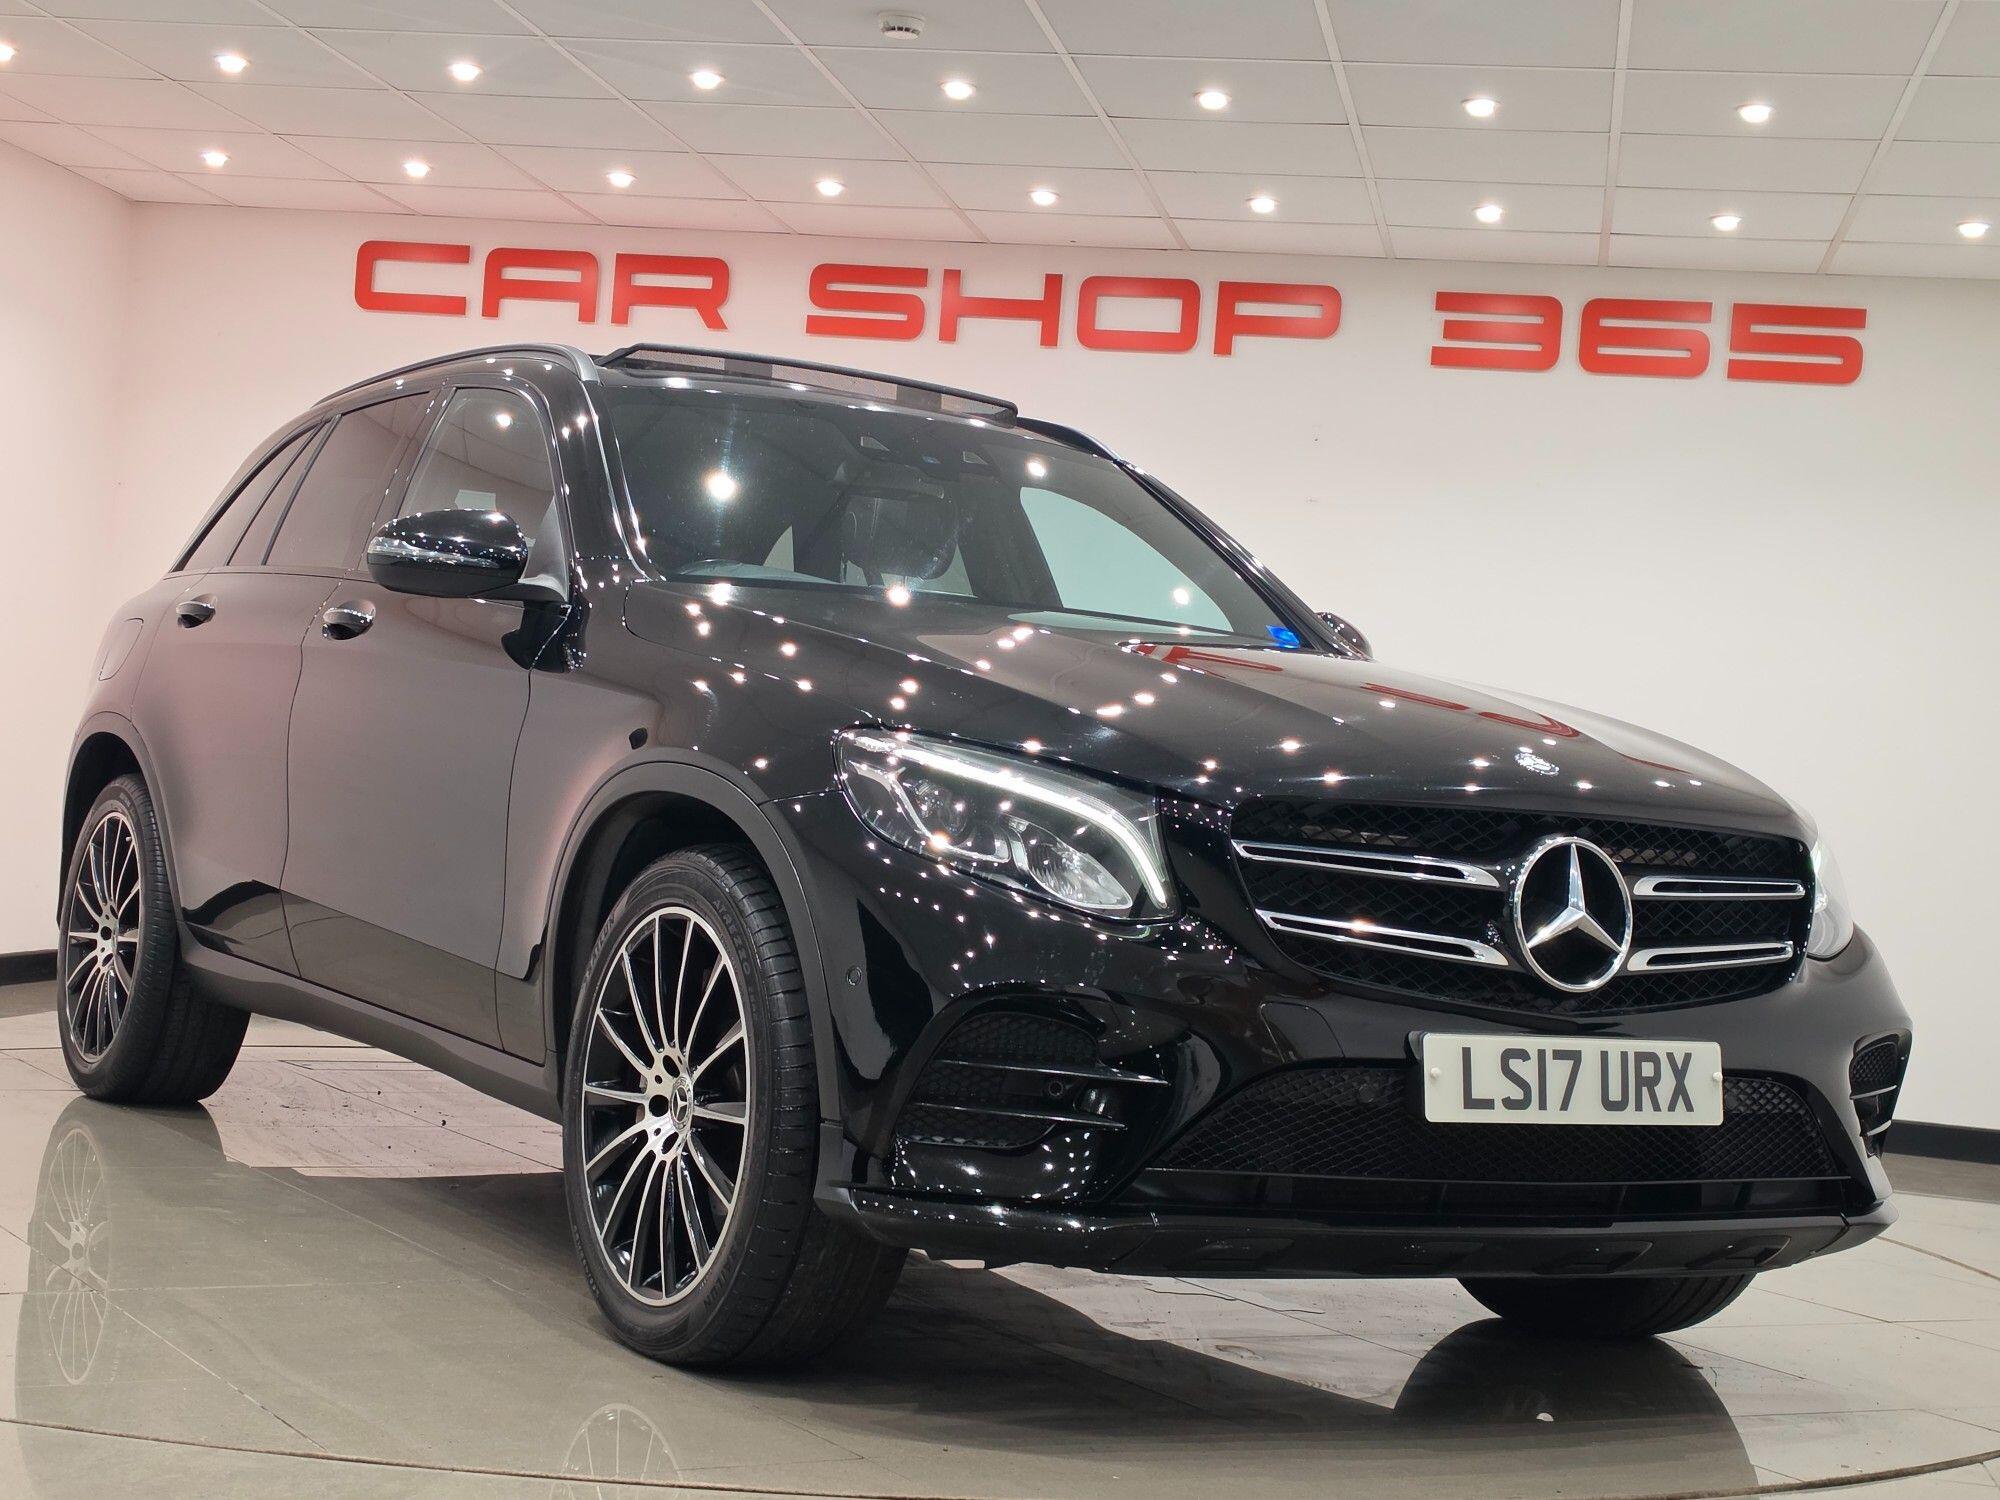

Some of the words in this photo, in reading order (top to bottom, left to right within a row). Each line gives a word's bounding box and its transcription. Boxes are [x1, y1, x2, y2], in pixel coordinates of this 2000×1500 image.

[355, 240, 730, 330] CAR
[805, 263, 1341, 356] SHOP
[1430, 291, 1867, 386] 365
[1461, 1046, 1583, 1112] LS17
[1600, 1050, 1695, 1113] URX
